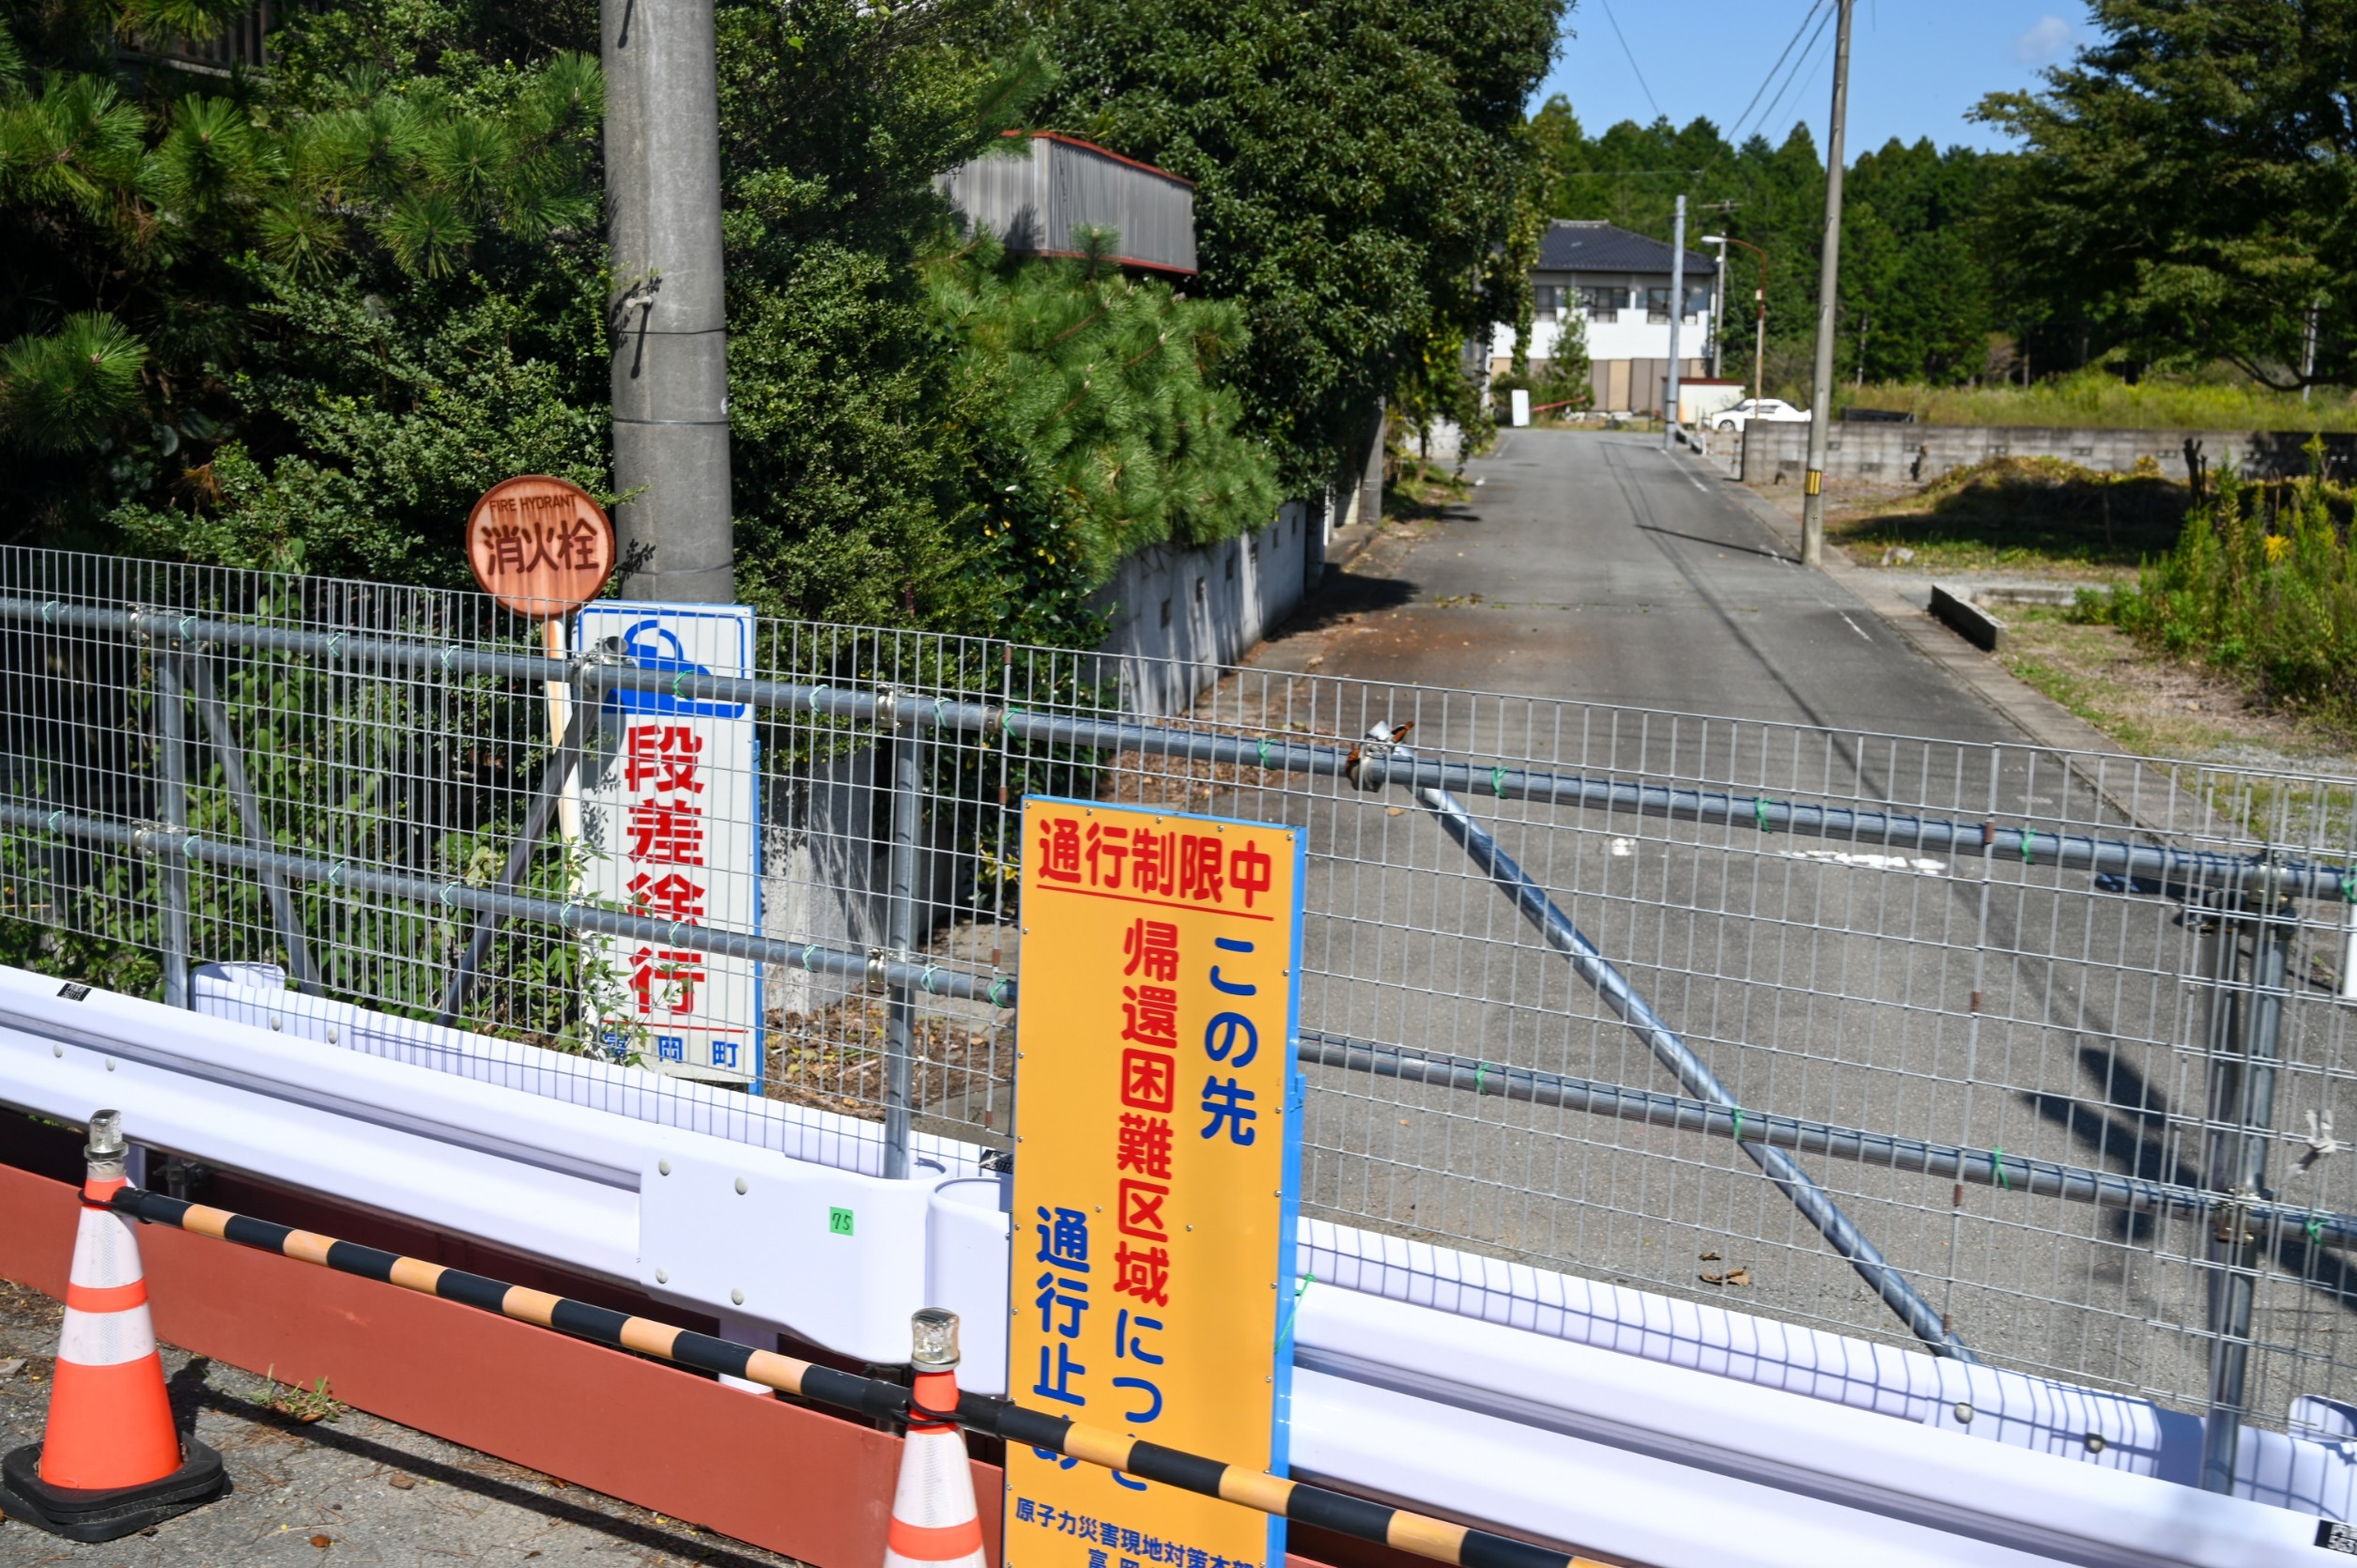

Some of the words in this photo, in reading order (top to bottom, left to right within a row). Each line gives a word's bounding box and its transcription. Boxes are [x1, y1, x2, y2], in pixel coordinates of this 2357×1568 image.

[489, 498, 516, 513] FIRE
[519, 494, 578, 511] HYDRANT
[480, 517, 600, 576] 消火栓
[624, 724, 706, 1016] 段差徐行
[1037, 817, 1271, 909] 通行制限中
[1200, 936, 1259, 1147] この先
[832, 1212, 852, 1231] 75
